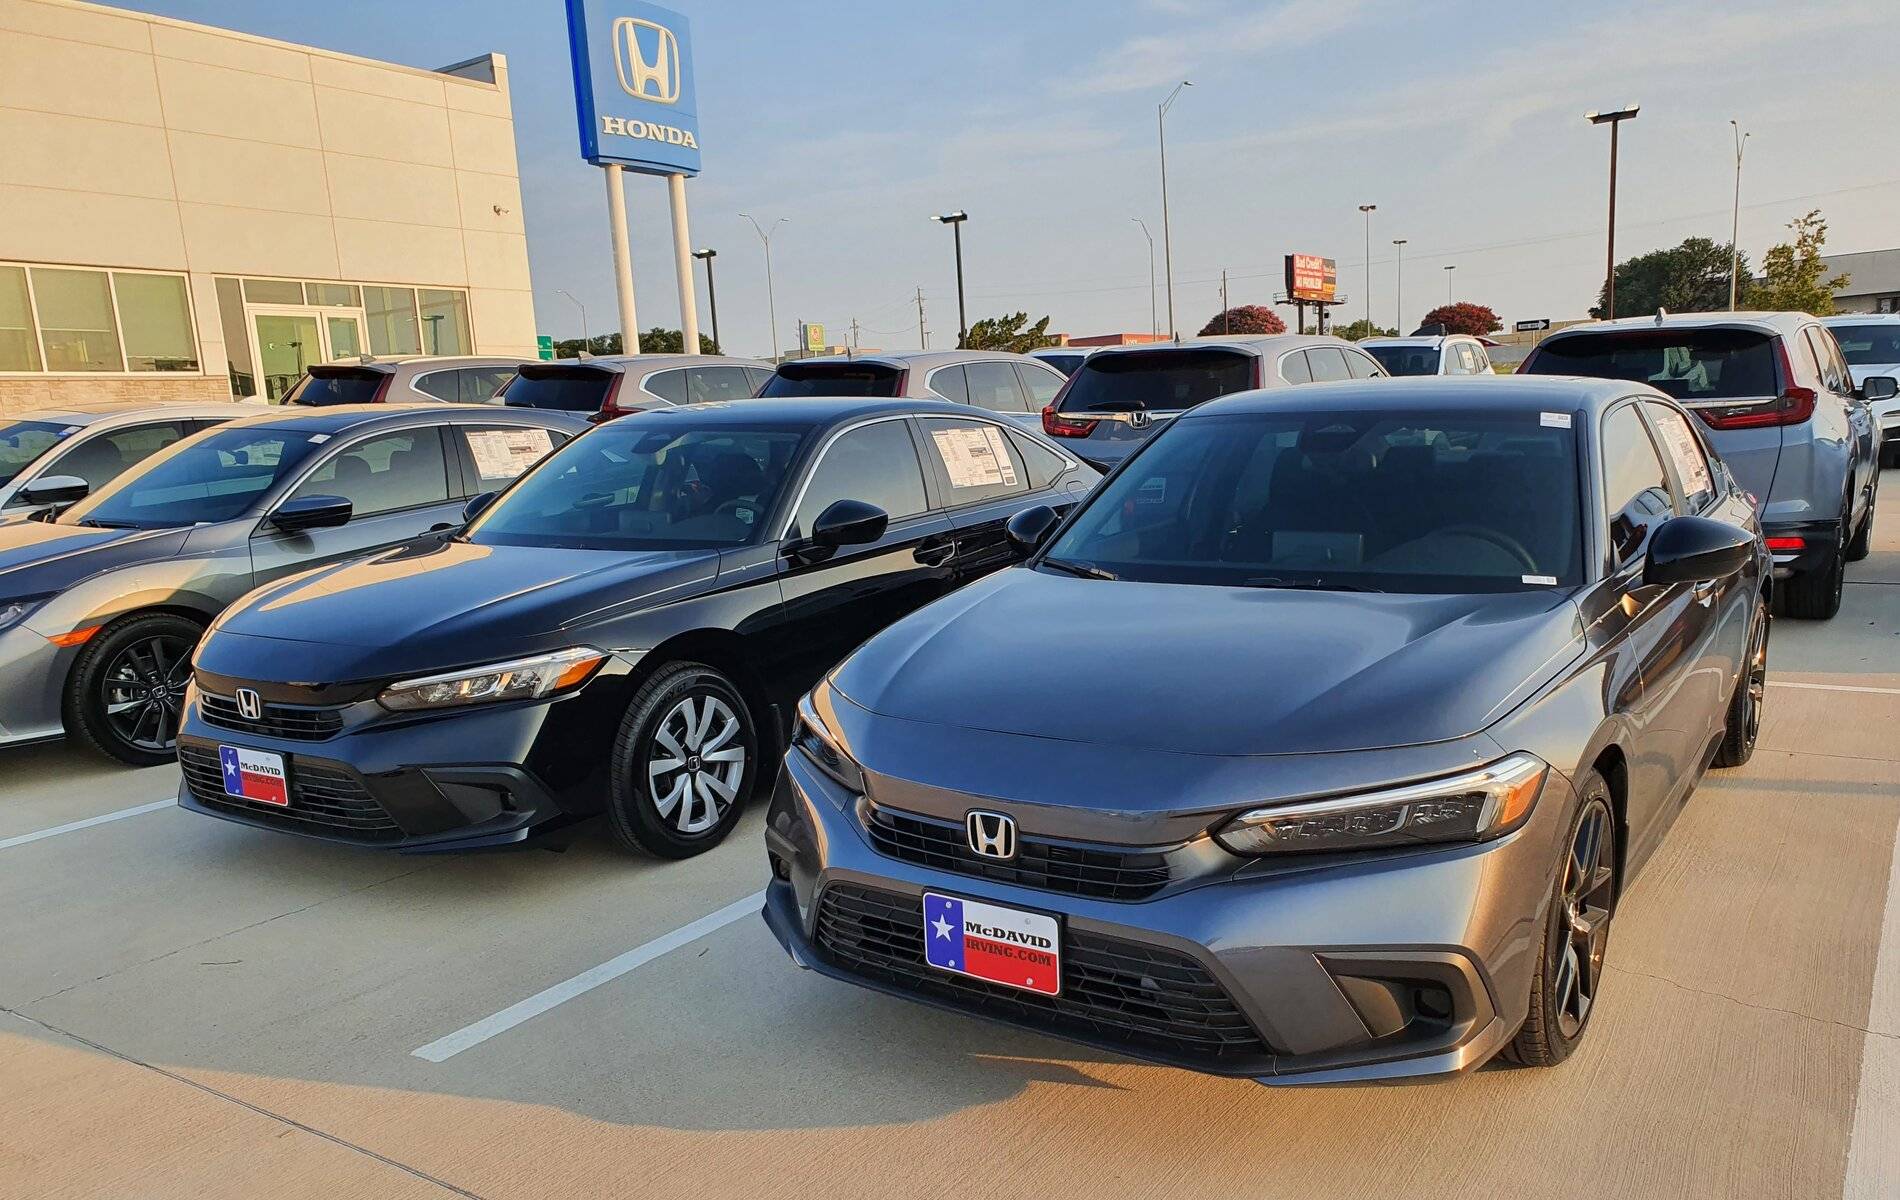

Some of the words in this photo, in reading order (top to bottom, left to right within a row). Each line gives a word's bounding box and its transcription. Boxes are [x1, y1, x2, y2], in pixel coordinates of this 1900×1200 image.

[602, 115, 698, 149] HONDA
[240, 762, 281, 775] McDAVID
[965, 921, 1052, 949] McDAVID
[966, 938, 1052, 967] IRVING.COM
